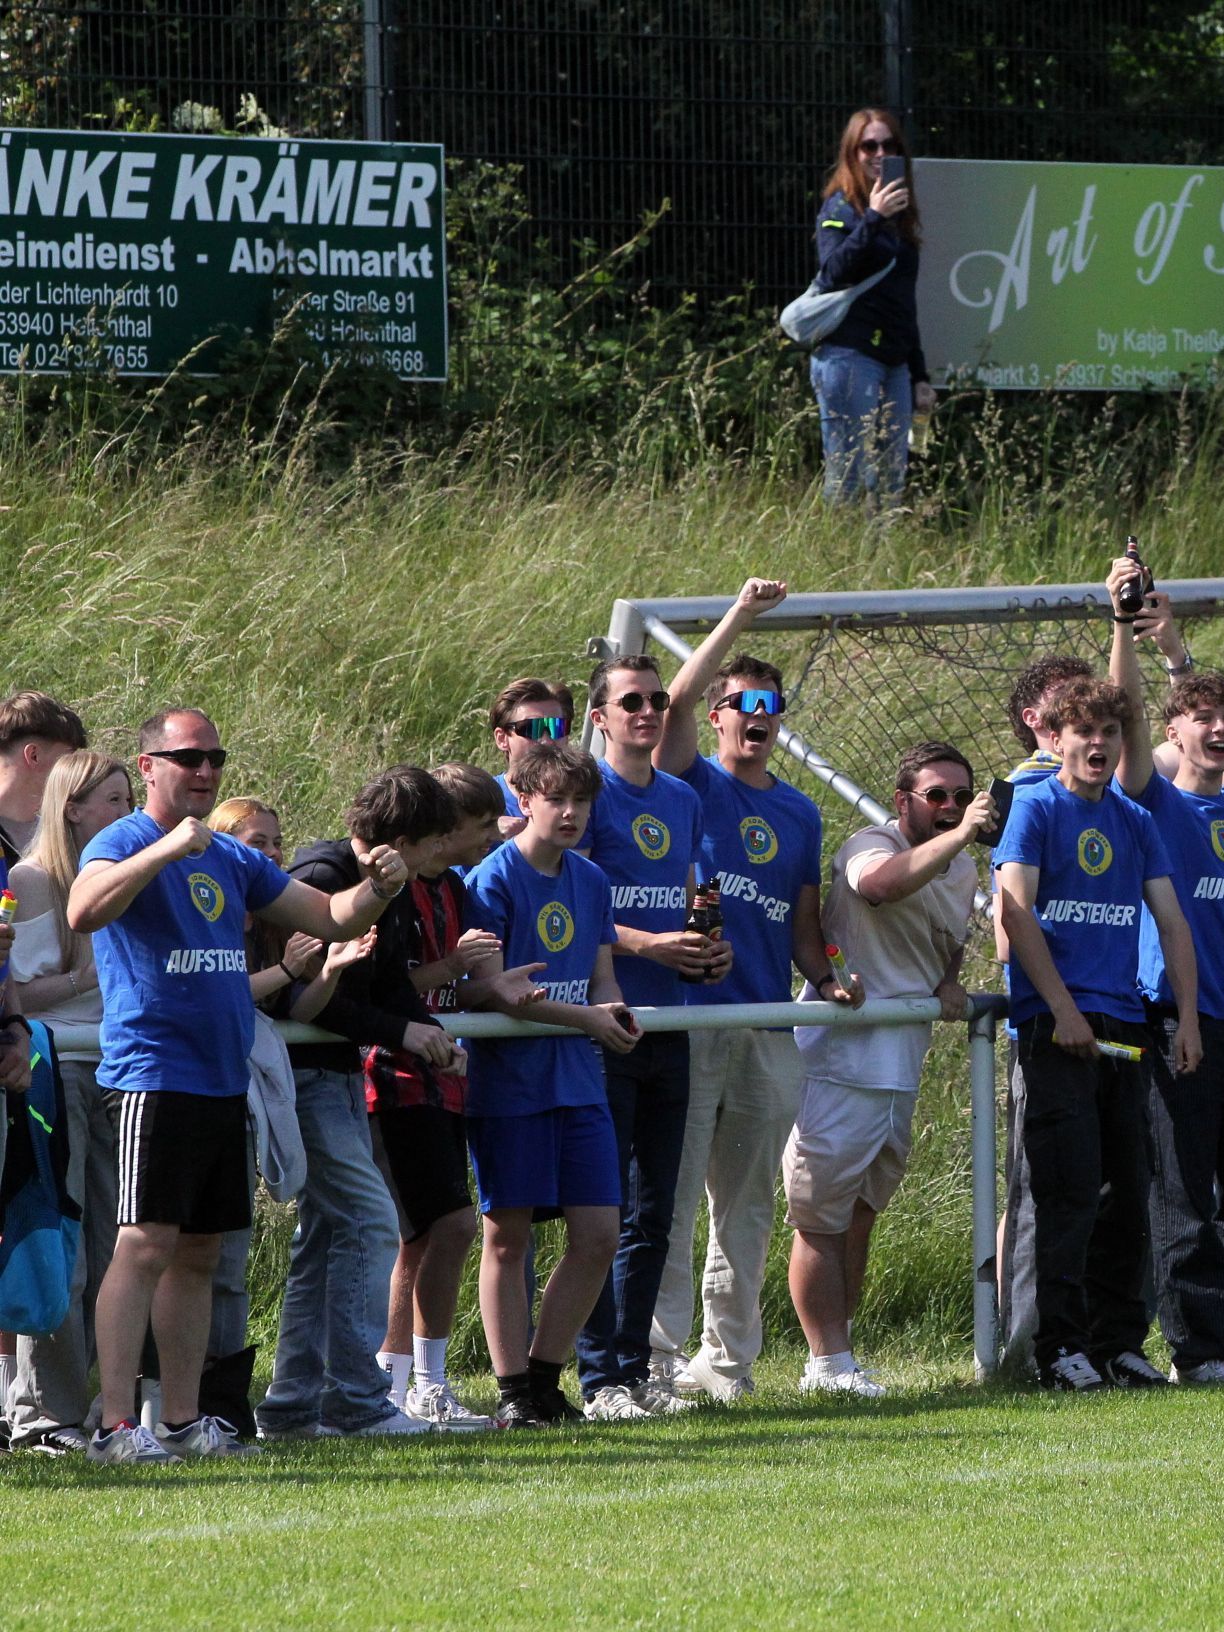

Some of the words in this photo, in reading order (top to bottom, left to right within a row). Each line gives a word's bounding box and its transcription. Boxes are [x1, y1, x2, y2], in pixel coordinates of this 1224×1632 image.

[170, 142, 438, 229] KRÄMER
[229, 237, 434, 279] Abholmarkt
[949, 183, 1098, 334] Art
[1133, 174, 1204, 286] of
[36, 281, 151, 308] Lichtenhardt
[156, 284, 178, 308] 10
[333, 289, 390, 313] Straße
[394, 291, 415, 314] 91
[1097, 328, 1117, 357] by
[1123, 327, 1168, 358] Katja
[1041, 900, 1136, 927] AUFSTEIGER
